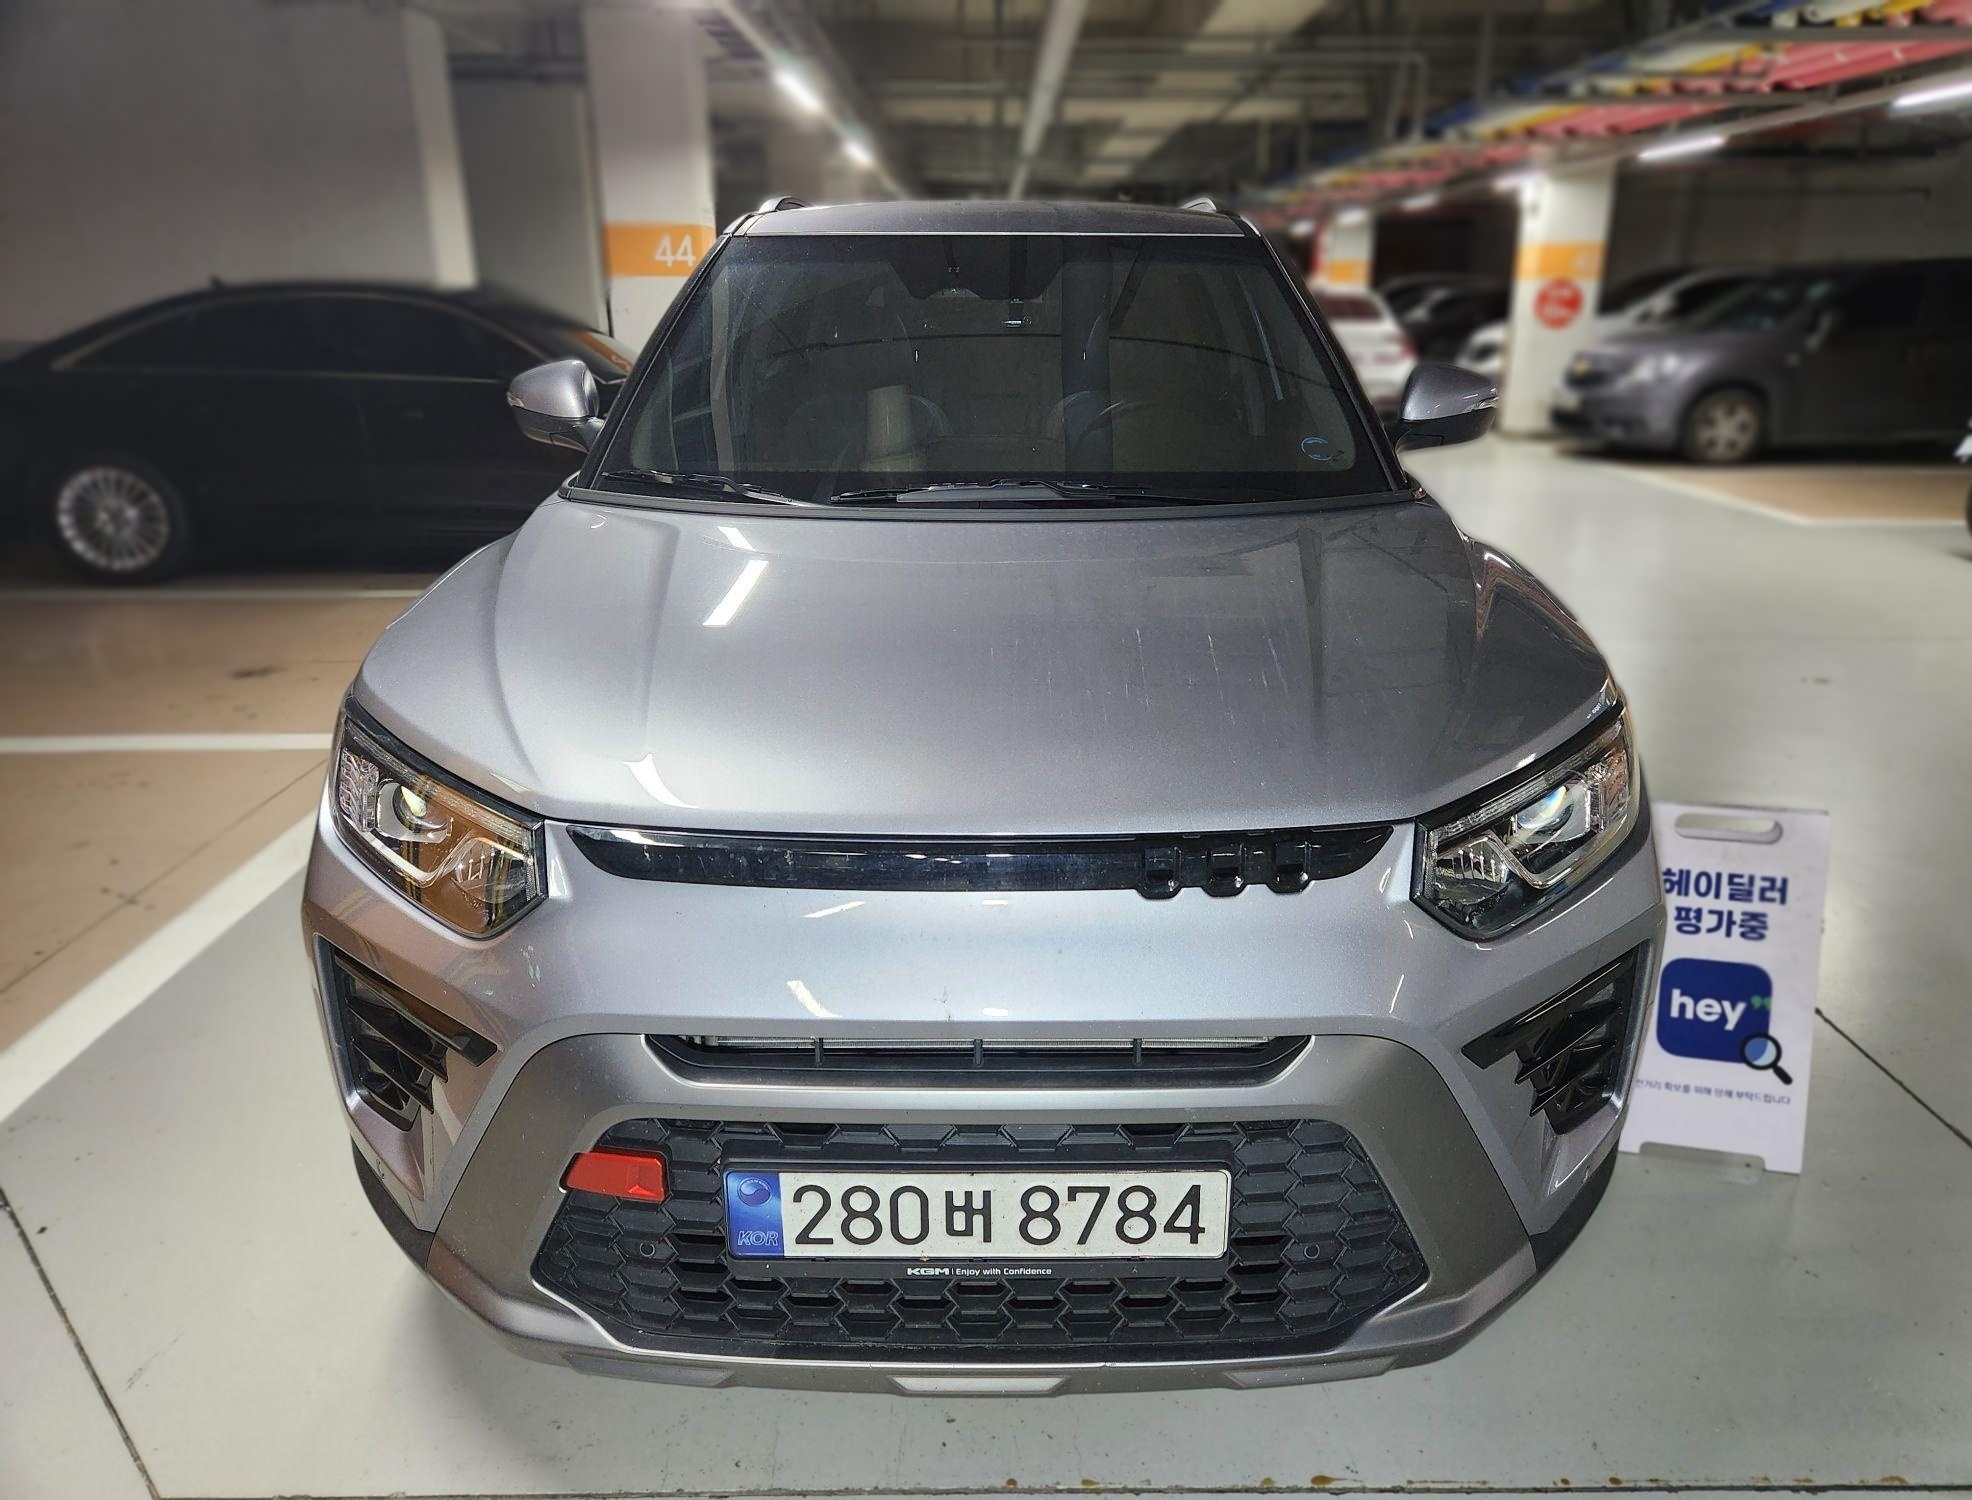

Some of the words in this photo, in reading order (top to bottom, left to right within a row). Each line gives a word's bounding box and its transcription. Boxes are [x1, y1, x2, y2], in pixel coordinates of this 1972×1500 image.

[653, 234, 697, 267] 44
[1662, 867, 1789, 906] 헤이딜러
[1674, 905, 1769, 941] 평가중
[1670, 988, 1747, 1031] hey
[1694, 1085, 1712, 1096] 위해
[1714, 1087, 1734, 1099] 양해
[1736, 1090, 1791, 1106] 부탁드립니다
[792, 1184, 992, 1246] 280버
[1018, 1184, 1206, 1246] 8784
[737, 1230, 779, 1247] KOR
[906, 1267, 950, 1276] KGM
[955, 1267, 981, 1276] Enjoy
[982, 1267, 1001, 1276] with
[1003, 1267, 1052, 1275] Confidence
